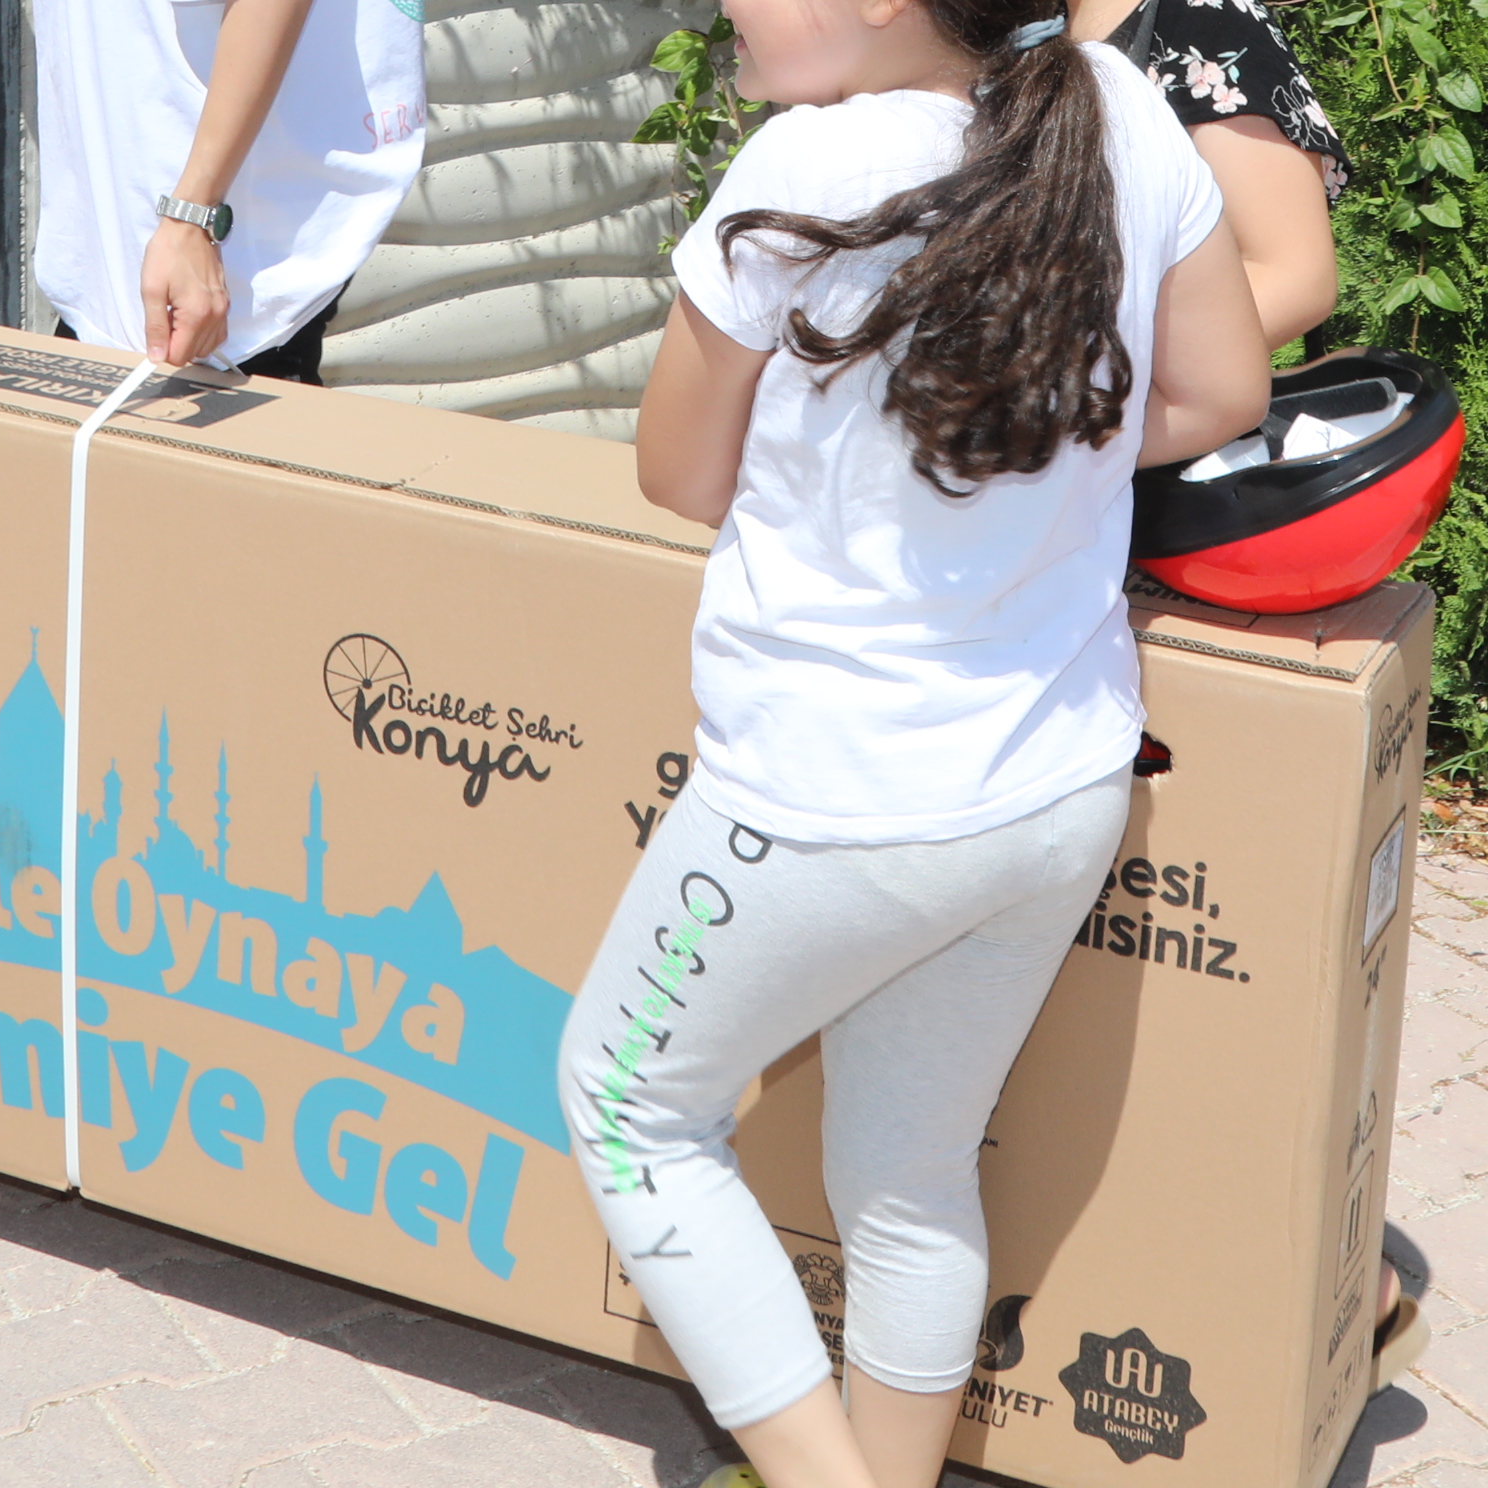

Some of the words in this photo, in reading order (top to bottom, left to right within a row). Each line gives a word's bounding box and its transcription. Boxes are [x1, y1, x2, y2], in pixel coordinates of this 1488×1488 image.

[63, 357, 167, 384] FAGILE
[388, 684, 499, 730] Bisiklet
[507, 707, 583, 749] Şehri
[353, 686, 551, 808] Konya
[92, 856, 466, 1065] Oynaya
[293, 1076, 527, 1282] Gel
[813, 1311, 844, 1330] NYA
[959, 1399, 1008, 1428] ULU
[965, 1377, 1049, 1417] NİYET
[1083, 1389, 1179, 1434] ATABEY
[1104, 1418, 1154, 1445] Gençlik
